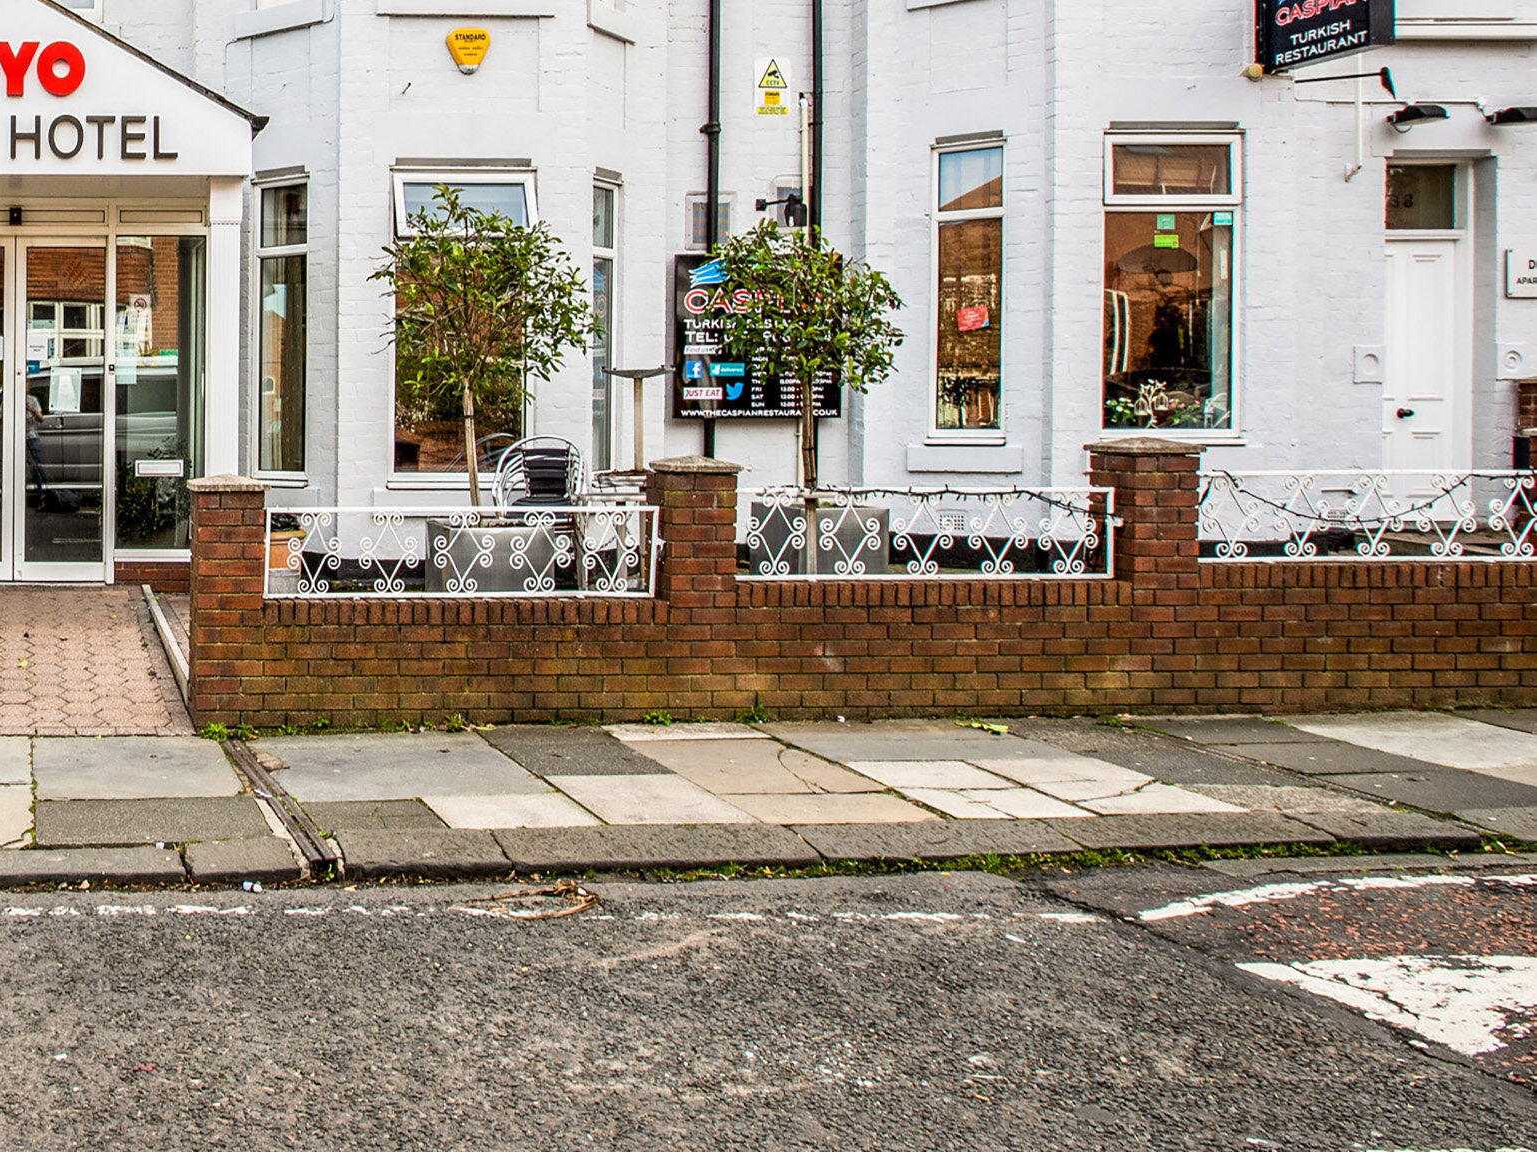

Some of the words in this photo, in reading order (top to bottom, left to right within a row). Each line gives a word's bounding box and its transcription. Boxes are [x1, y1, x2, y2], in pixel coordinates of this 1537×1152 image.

[1290, 19, 1352, 46] TURKISH
[1275, 30, 1368, 65] RESTAURANT
[10, 114, 179, 161] HOTEL
[685, 331, 719, 343] TEL:
[685, 389, 703, 398] JUST
[705, 389, 720, 397] EAT
